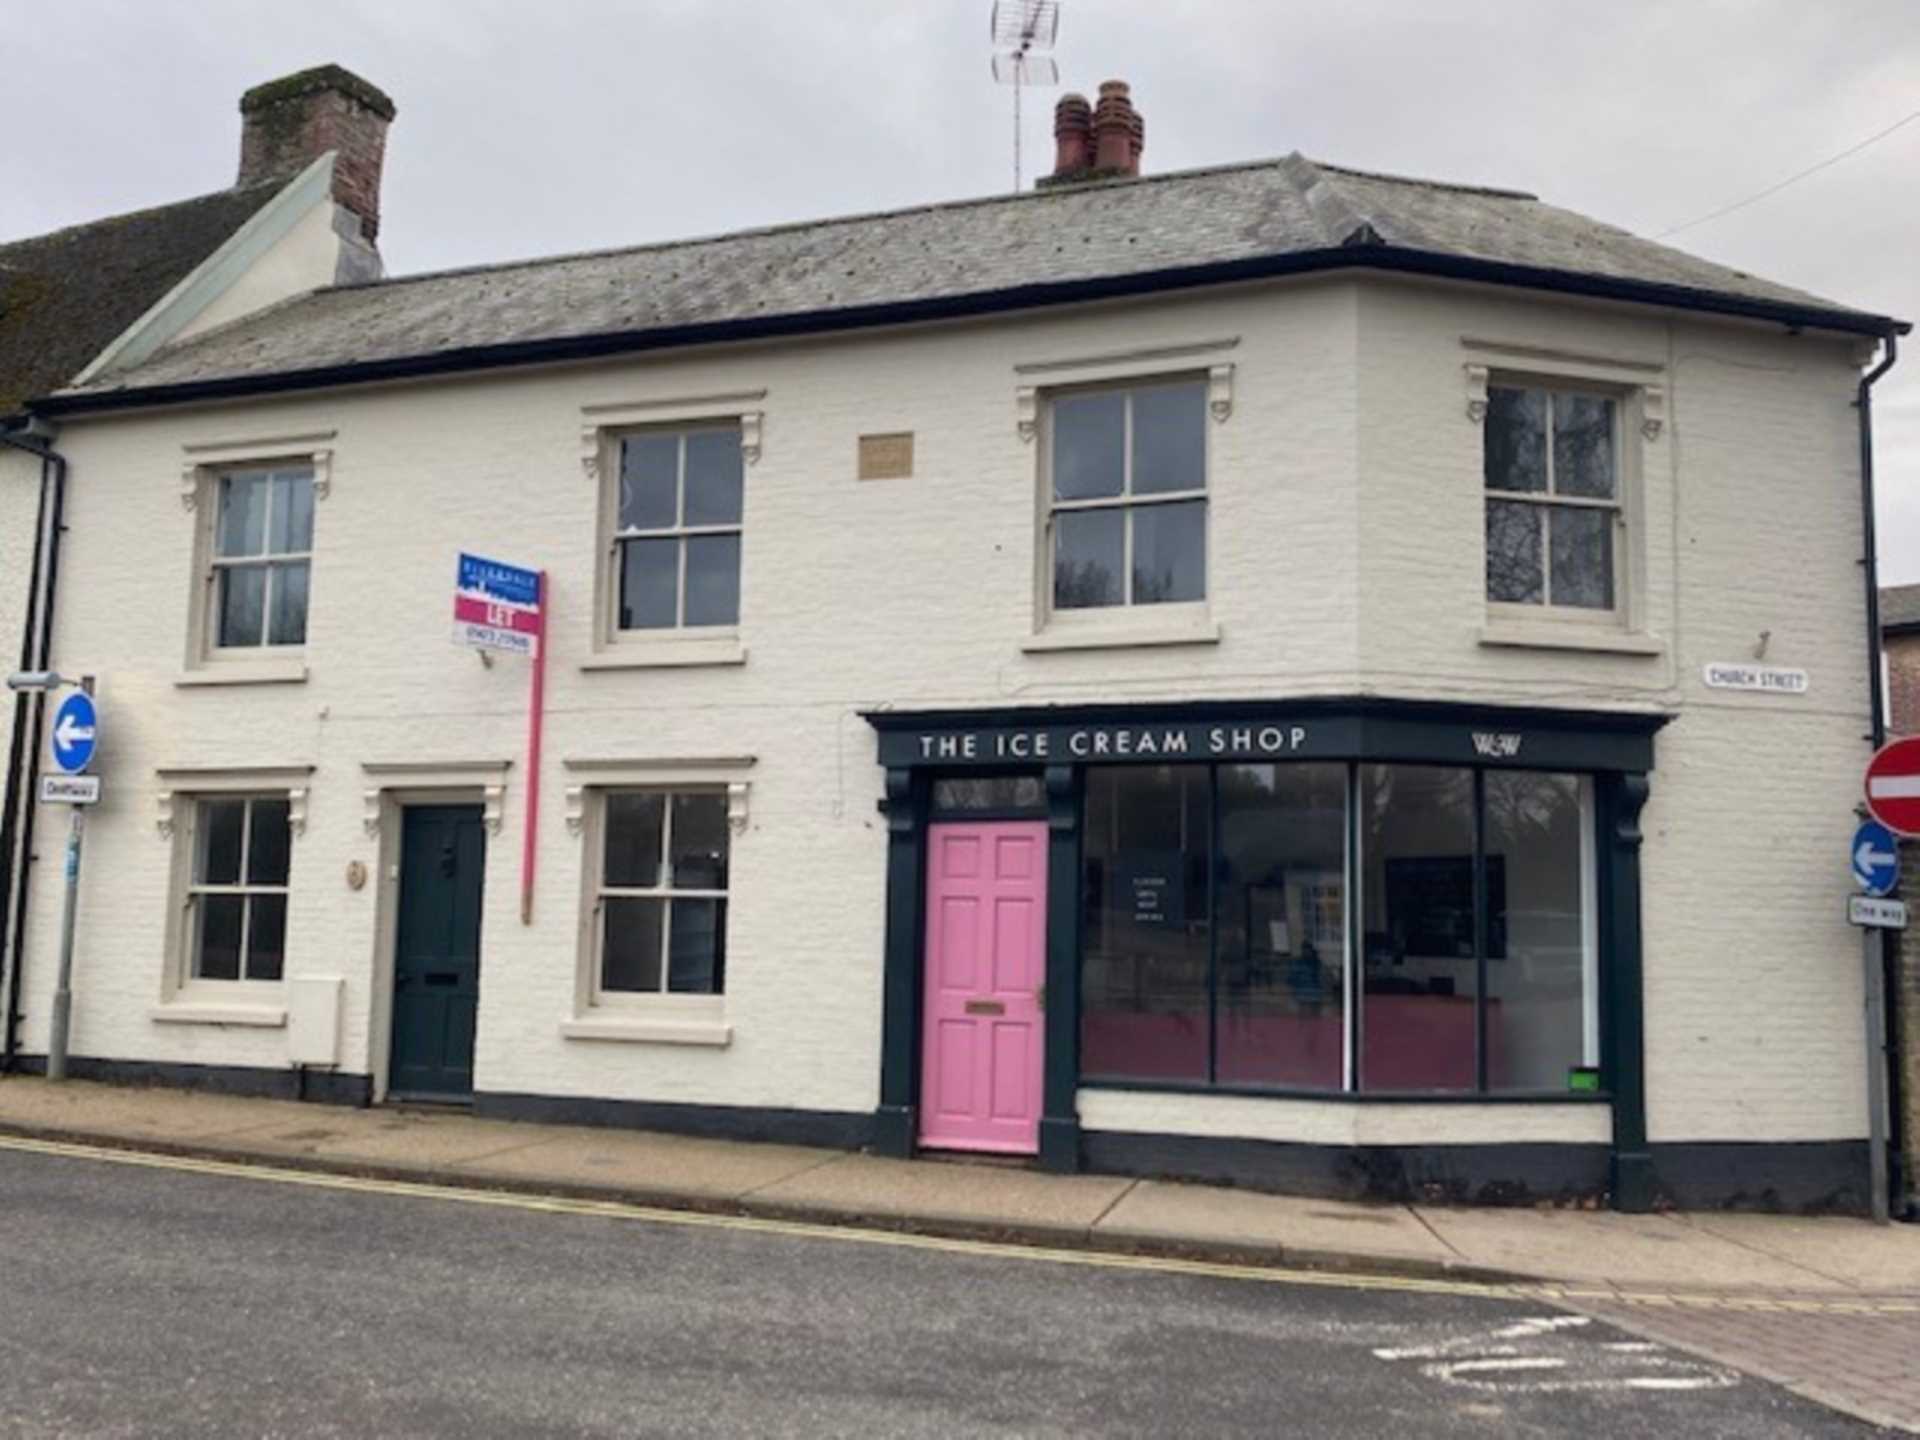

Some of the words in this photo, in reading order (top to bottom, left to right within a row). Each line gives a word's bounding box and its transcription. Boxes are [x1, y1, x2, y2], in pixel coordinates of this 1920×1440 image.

[487, 604, 515, 627] LET
[1710, 668, 1756, 685] CHURCH
[1759, 671, 1804, 689] STREET
[920, 734, 977, 758] THE
[997, 732, 1049, 757] ICE
[1069, 730, 1188, 756] CREAM
[1209, 726, 1306, 753] SHOP
